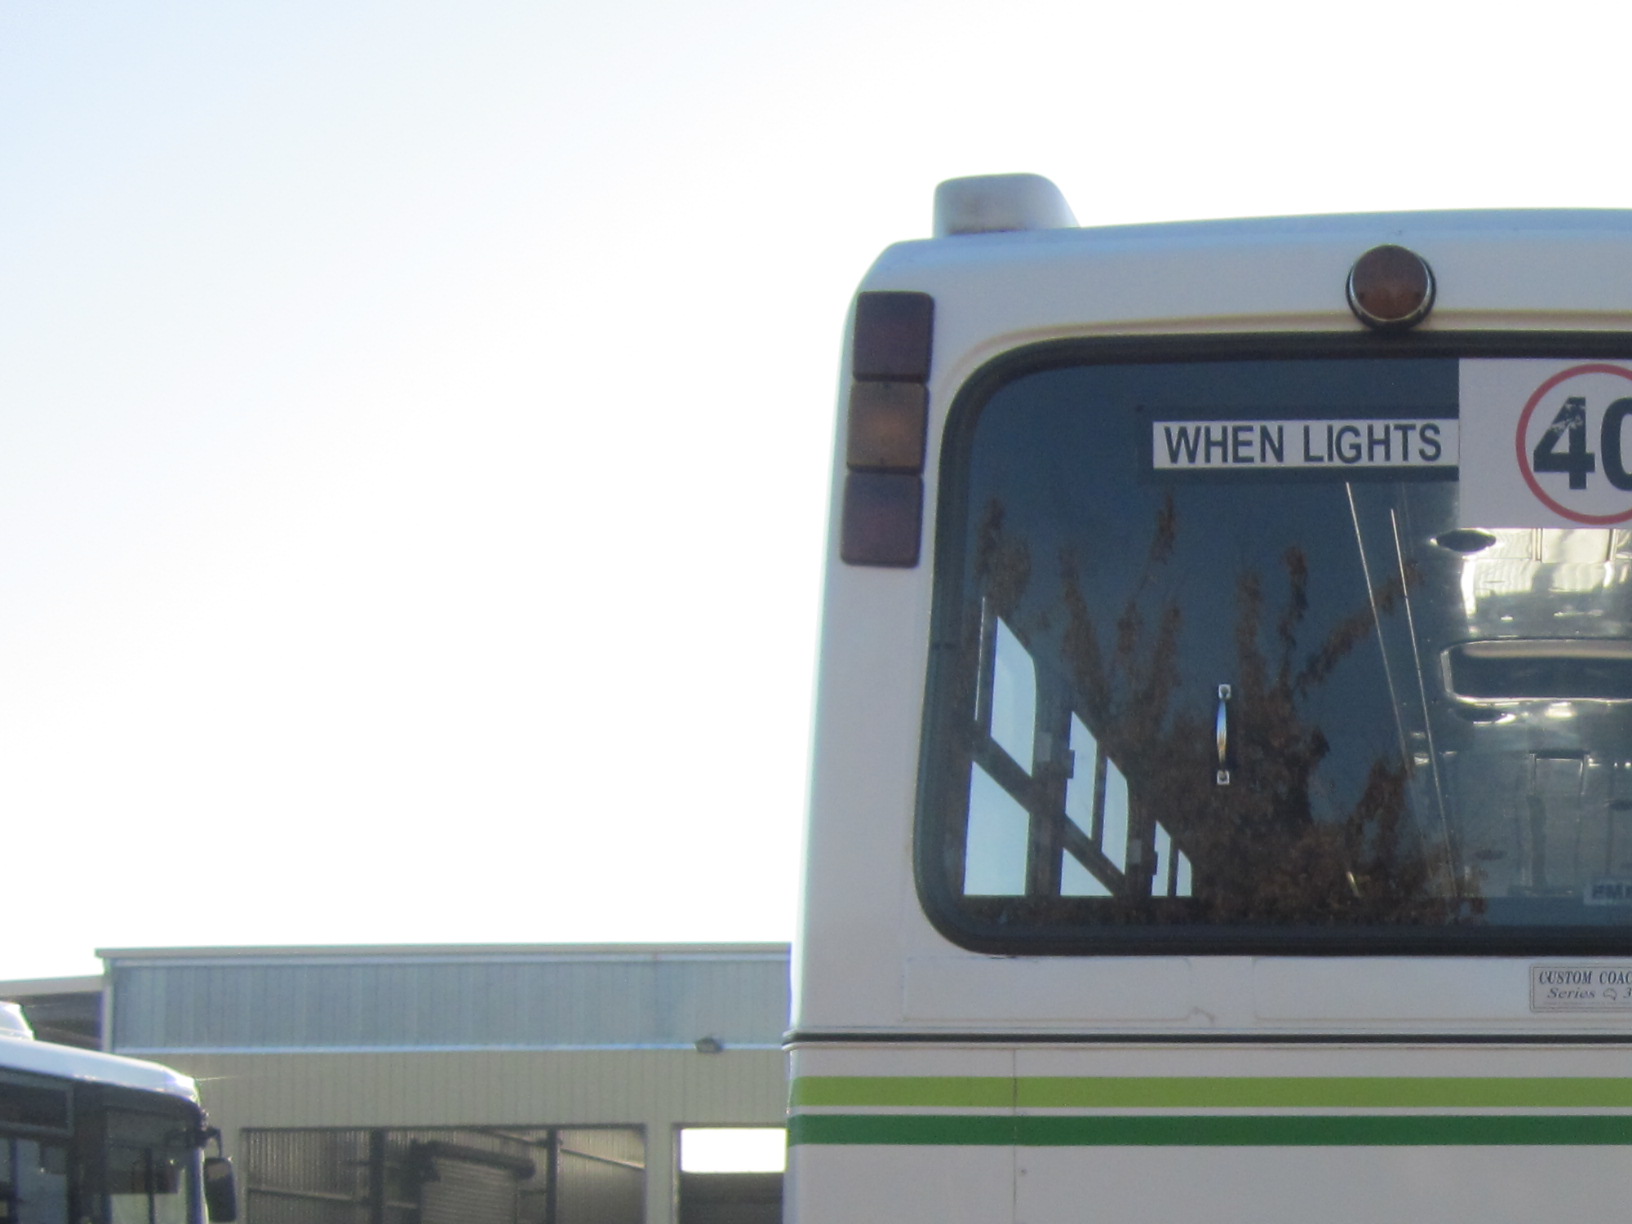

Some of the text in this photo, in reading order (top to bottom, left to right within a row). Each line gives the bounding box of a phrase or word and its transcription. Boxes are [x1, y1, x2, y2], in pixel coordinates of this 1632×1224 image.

[1163, 422, 1442, 464] WHEN LIGHTS
[1539, 970, 1593, 985] CUSTOM
[1547, 987, 1596, 999] Series
